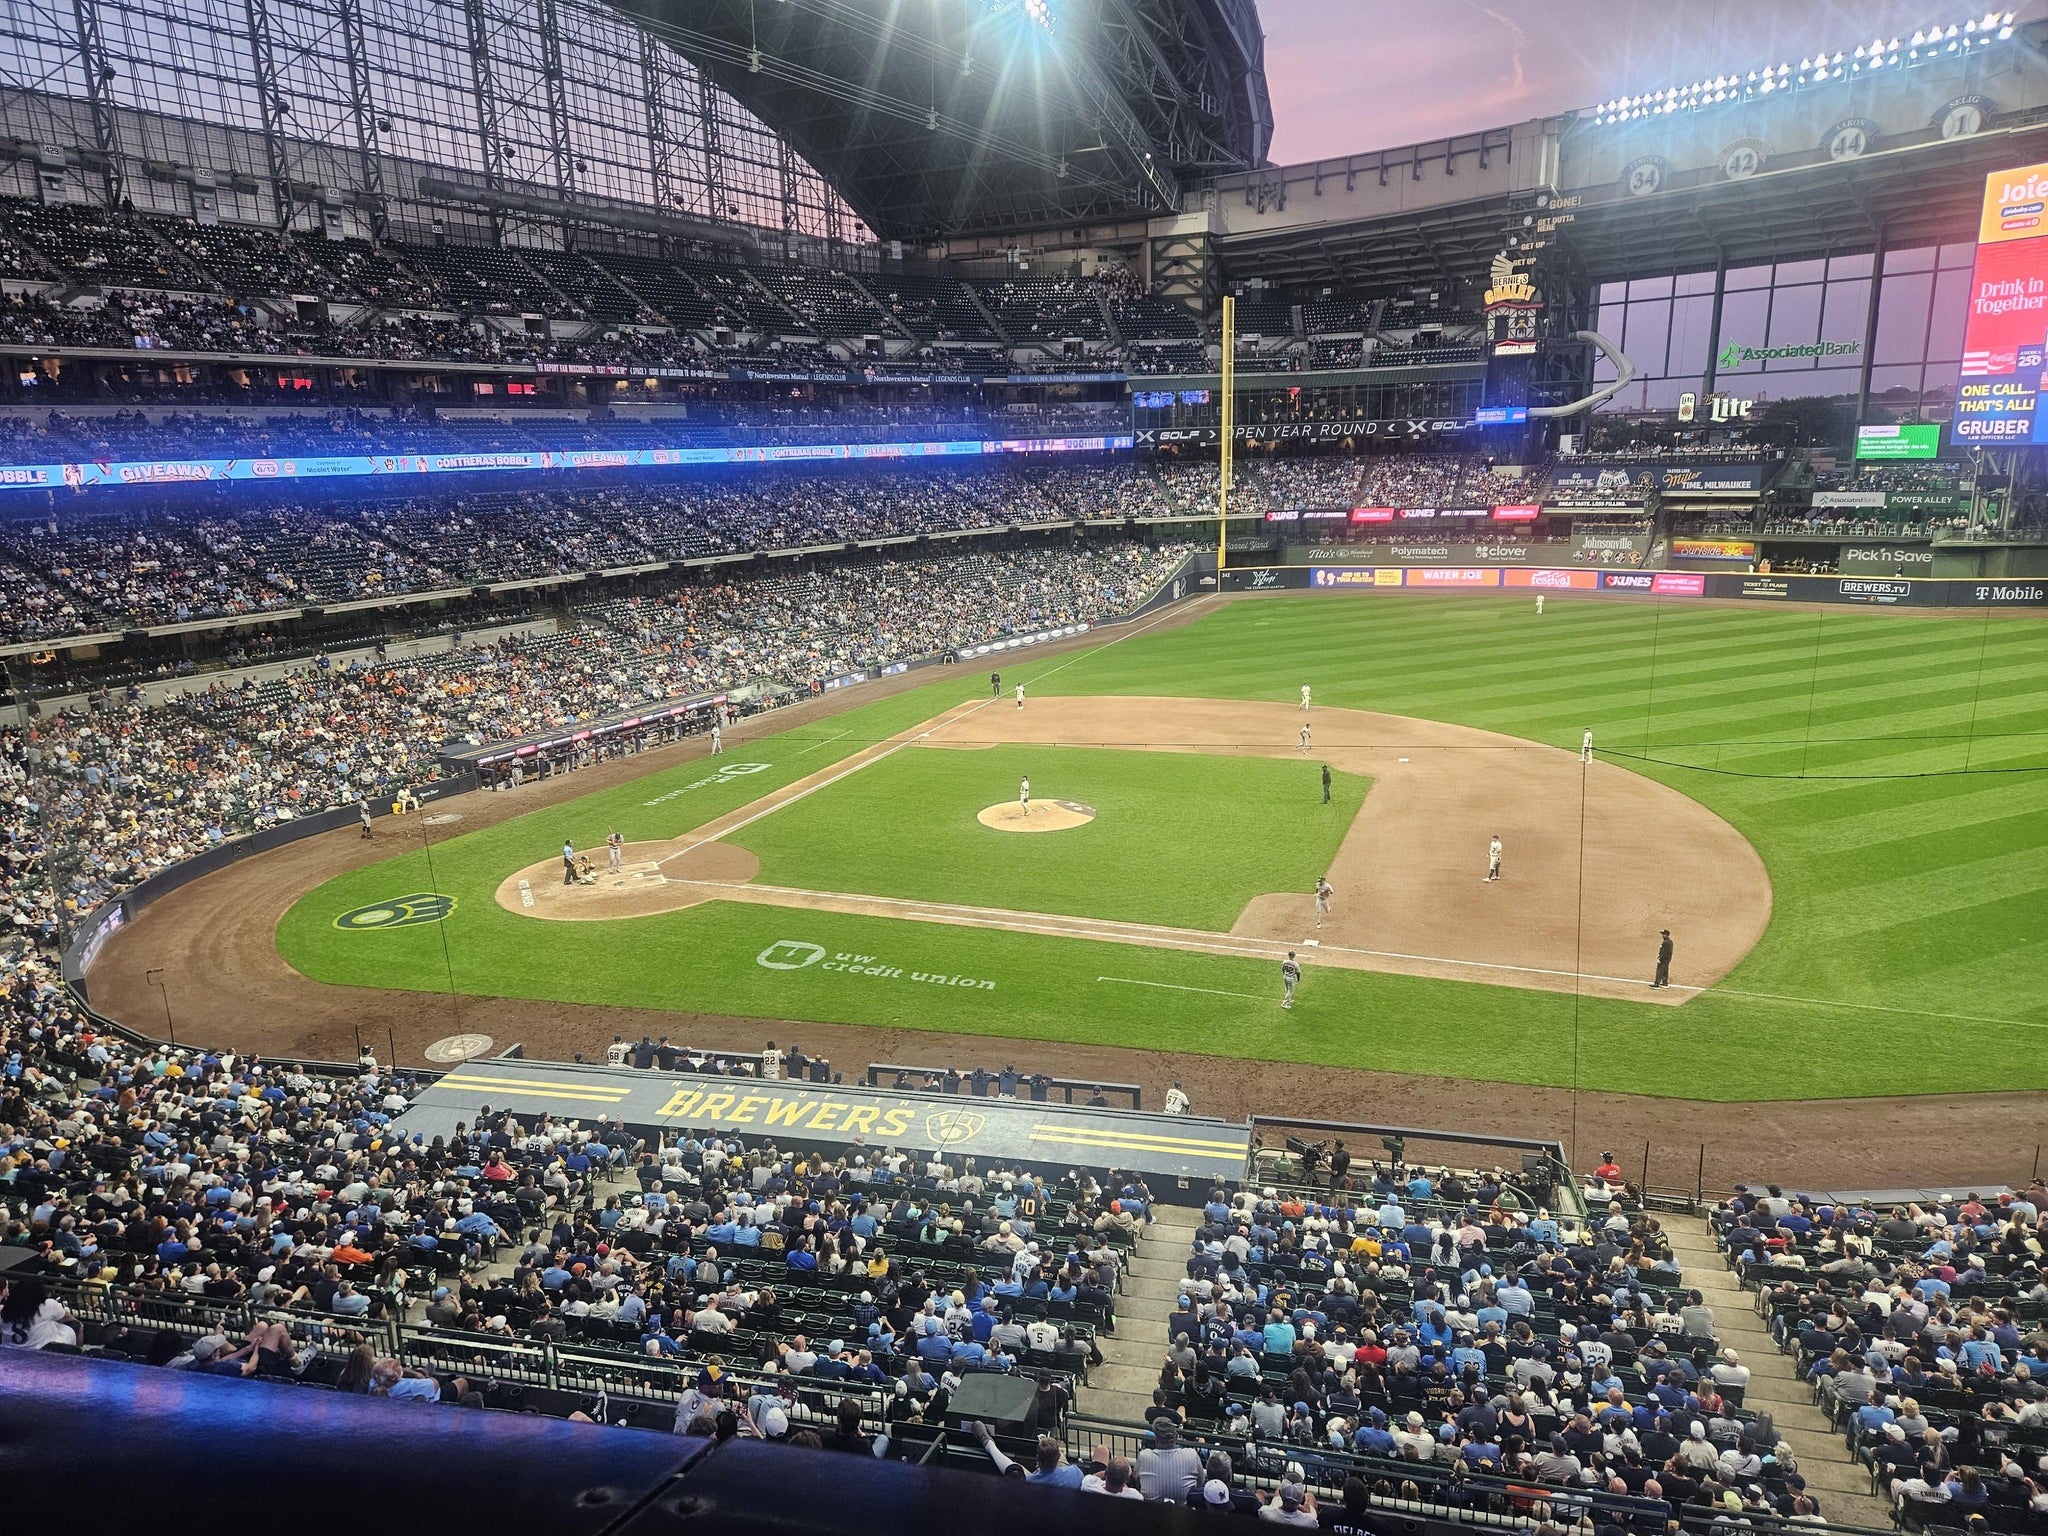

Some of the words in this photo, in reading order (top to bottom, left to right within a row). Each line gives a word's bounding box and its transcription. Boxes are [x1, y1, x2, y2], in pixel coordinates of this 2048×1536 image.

[1949, 94, 1982, 109] SELIG
[1835, 118, 1866, 132] AARON
[1956, 114, 1969, 134] 1
[1722, 138, 1763, 155] ROBINSON
[1834, 135, 1860, 156] 44
[1629, 156, 1664, 171] FINGERS
[1729, 153, 1754, 173] 42
[1634, 172, 1657, 189] 34
[1998, 174, 2048, 204] Joie
[1550, 196, 1581, 209] GONE!
[1538, 217, 1550, 225] GET
[1552, 214, 1575, 224] OUTTA
[1537, 224, 1556, 232] HERE
[1521, 242, 1534, 250] GET
[1536, 241, 1546, 249] UP
[1513, 258, 1526, 266] GET
[1527, 257, 1537, 266] UP
[1493, 273, 1529, 287] BERNIE'S
[1981, 278, 2025, 298] Drink
[2028, 277, 2043, 294] in
[1484, 284, 1536, 305] CHALET
[1974, 295, 2048, 315] Together
[2018, 354, 2042, 367] 250
[754, 371, 790, 380] Northwestern
[1961, 385, 1990, 397] ONE
[1992, 383, 2036, 396] CALL...
[1682, 396, 1694, 405] Lite
[1959, 399, 2004, 412] THAT'S
[2005, 398, 2036, 411] ALL!
[1710, 397, 1753, 423] Lite
[1226, 425, 1267, 439] OPEN
[1272, 425, 1313, 439] YEAR
[1320, 422, 1377, 435] ROUND
[1407, 420, 1428, 433] X
[1432, 420, 1477, 431] GOLF
[1957, 419, 2030, 435] GRUBER
[1136, 430, 1155, 443] X
[1160, 430, 1200, 440] GOLF
[436, 457, 495, 468] CONTRERAS
[496, 456, 533, 467] BOBBLE
[571, 454, 629, 466] GIVEAWAY
[119, 463, 215, 481] GIVEAWAY
[1663, 471, 1702, 488] Miller
[1682, 481, 1703, 490] TIME,
[1704, 480, 1752, 489] MILWAUKEE
[1892, 496, 1922, 504] POWER
[1923, 496, 1953, 504] ALLEY
[1272, 511, 1299, 520] KUNES
[1405, 509, 1435, 518] KUNES
[1582, 536, 1632, 549] Johnsonville
[1308, 549, 1336, 560] Tito's
[1391, 546, 1448, 557] Polymatech
[1489, 545, 1527, 556] clover
[1680, 544, 1722, 557] Surfside
[1847, 549, 1879, 560] Pick
[1894, 550, 1933, 563] Save
[1423, 570, 1459, 580] WATER
[1461, 570, 1482, 580] JOE
[1531, 574, 1570, 586] festival
[1614, 576, 1652, 588] KUNES
[1844, 582, 1906, 593] BREWERS.TV
[1992, 586, 2043, 600] Mobile
[834, 951, 877, 964] uw
[822, 961, 904, 979] credit
[910, 971, 997, 991] union
[608, 1051, 619, 1060] 68
[764, 1056, 775, 1065] 22
[671, 1080, 762, 1094] HOME
[798, 1091, 834, 1101] OF
[874, 1098, 938, 1110] THE
[654, 1089, 916, 1137] BREWERS
[1543, 1230, 1552, 1240] 2
[1037, 1332, 1043, 1343] 5
[1985, 1352, 1997, 1369] 11
